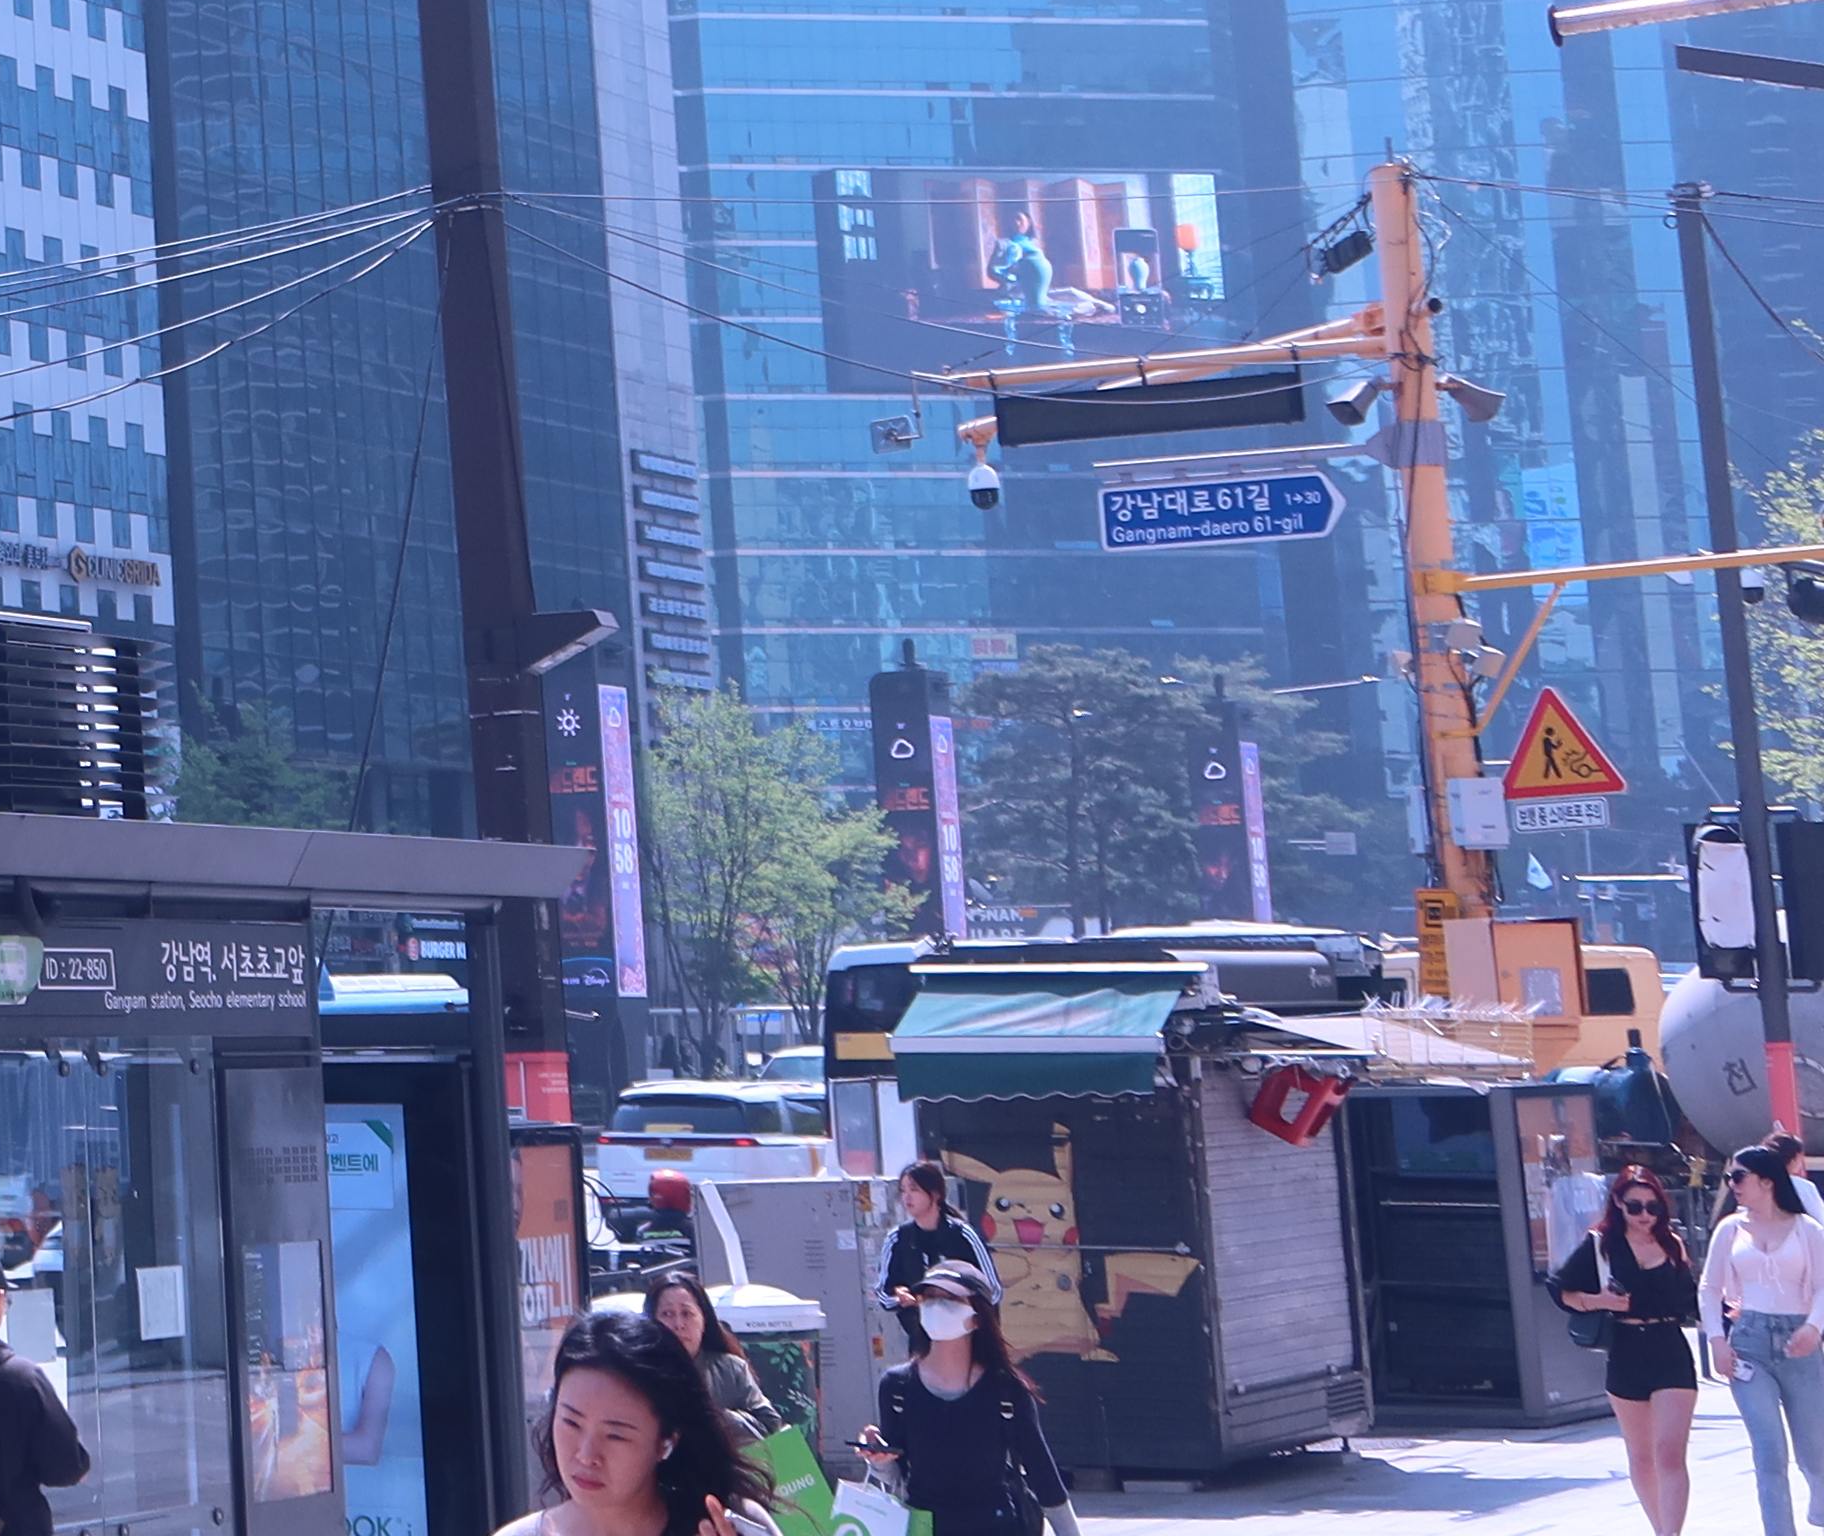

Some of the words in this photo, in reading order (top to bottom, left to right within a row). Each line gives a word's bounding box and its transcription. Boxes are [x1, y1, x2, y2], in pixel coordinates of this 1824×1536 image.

[1110, 482, 1271, 523] 강남대로61길
[1111, 517, 1251, 544] Gangnam-daero
[1253, 513, 1304, 534] 61-gil
[613, 808, 632, 840] 10
[614, 842, 635, 875] 58
[221, 941, 306, 984] 서초초교앞
[420, 940, 456, 960] BURGER
[68, 957, 108, 980] 22-850
[151, 991, 186, 1012] station,
[189, 991, 223, 1010] Seocho
[226, 990, 275, 1011] elementary
[278, 988, 308, 1009] school
